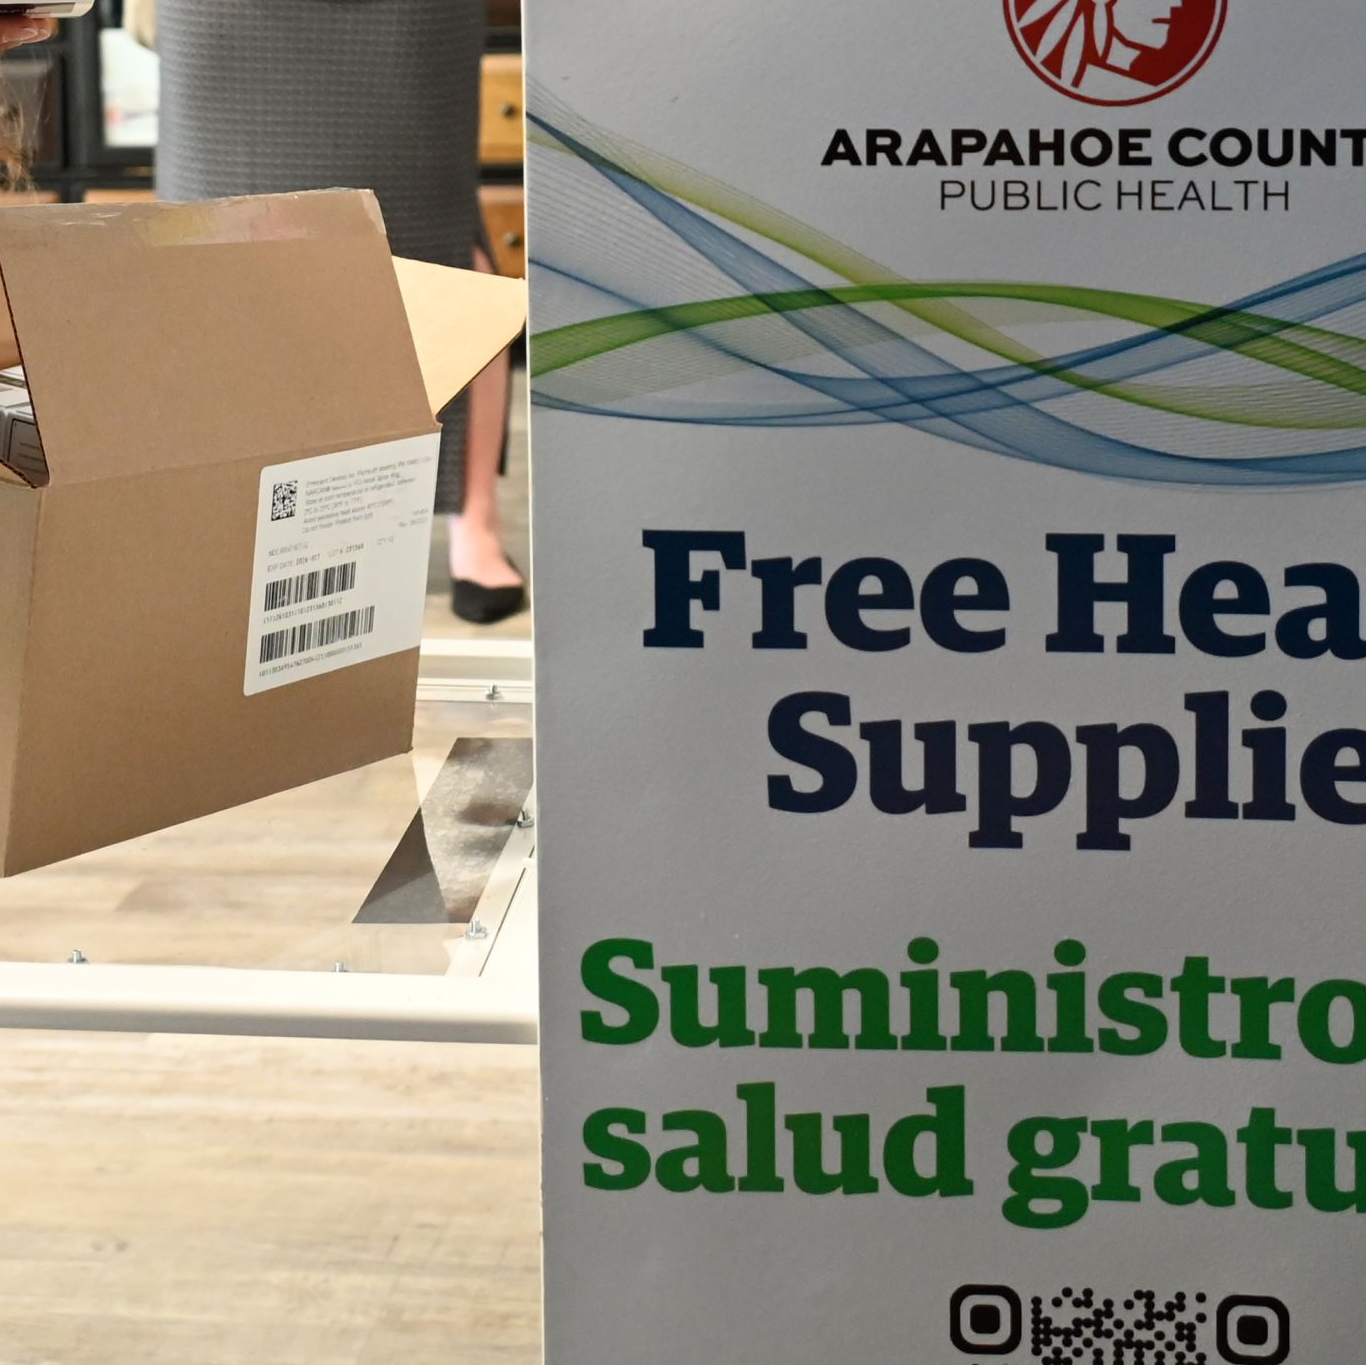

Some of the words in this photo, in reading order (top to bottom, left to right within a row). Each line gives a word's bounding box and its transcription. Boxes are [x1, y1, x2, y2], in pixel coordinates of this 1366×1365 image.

[820, 127, 1153, 167] ARAPAHOE
[939, 179, 1103, 212] PUBLIC
[1116, 179, 1291, 211] HEALTH
[641, 529, 1009, 653] Free
[581, 1081, 975, 1199] salud
